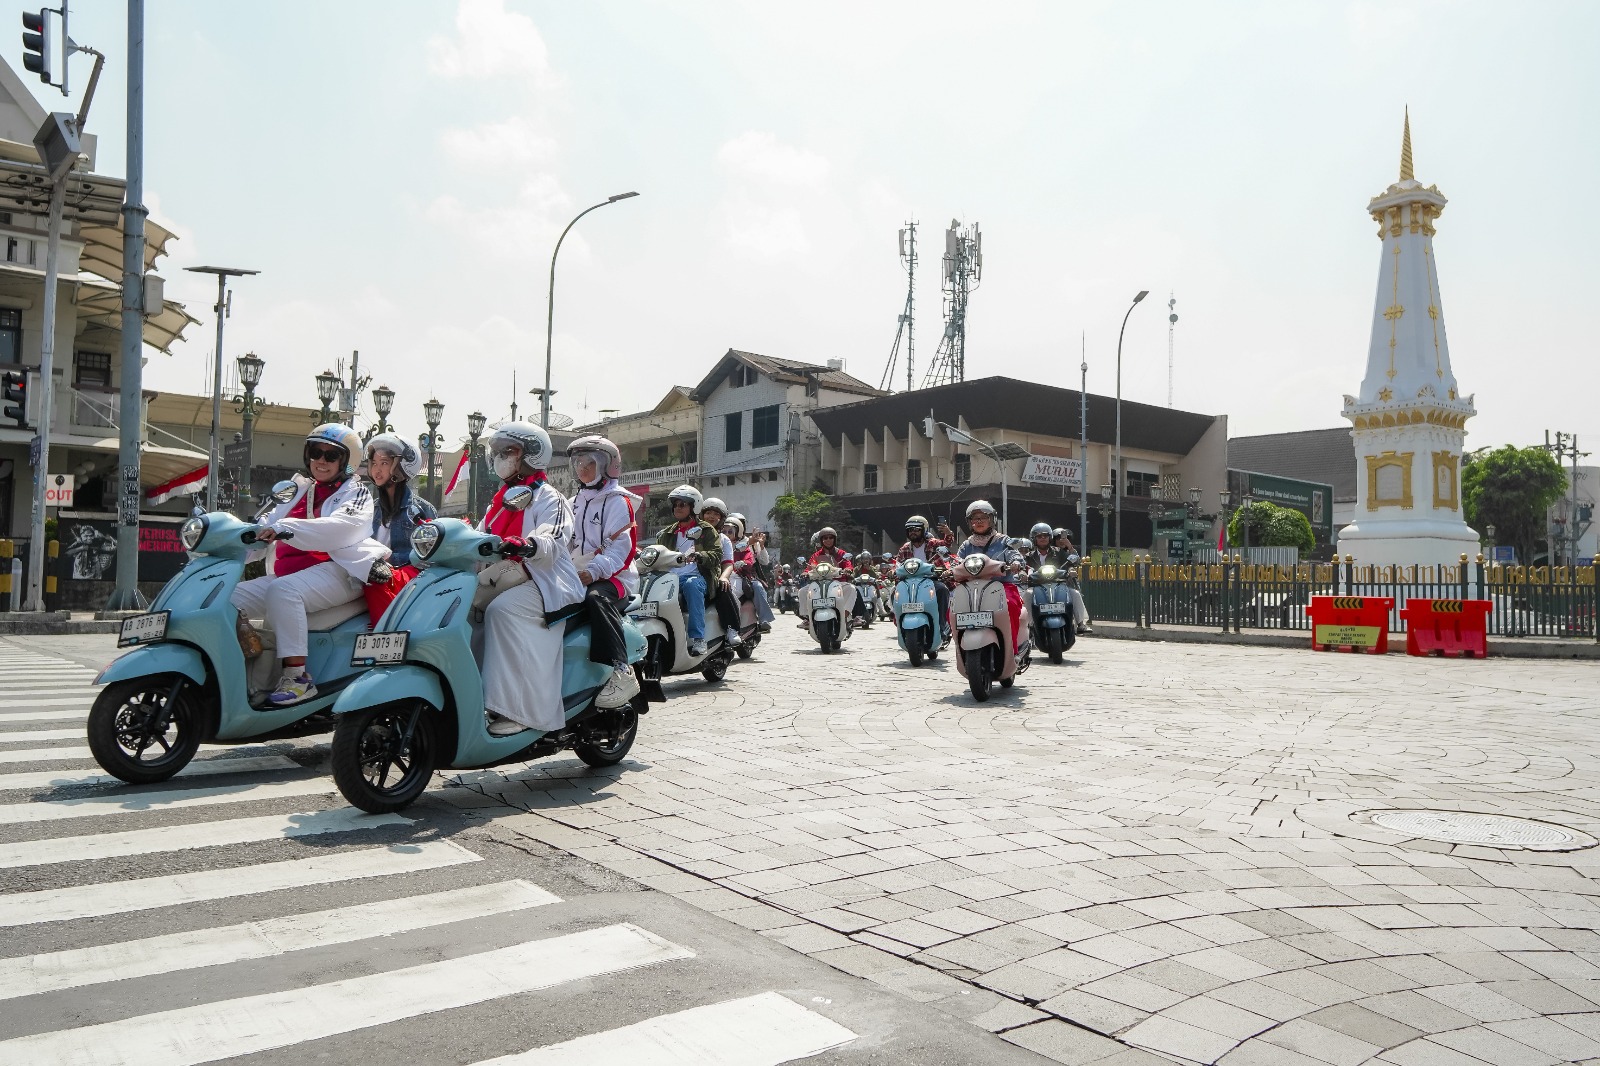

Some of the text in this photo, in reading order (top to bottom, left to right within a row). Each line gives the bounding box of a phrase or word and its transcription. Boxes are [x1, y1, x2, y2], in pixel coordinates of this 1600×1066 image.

[1035, 464, 1077, 477] MURAH
[46, 489, 72, 501] OUT
[124, 620, 133, 631] AB
[357, 636, 404, 649] AB 3079 HV
